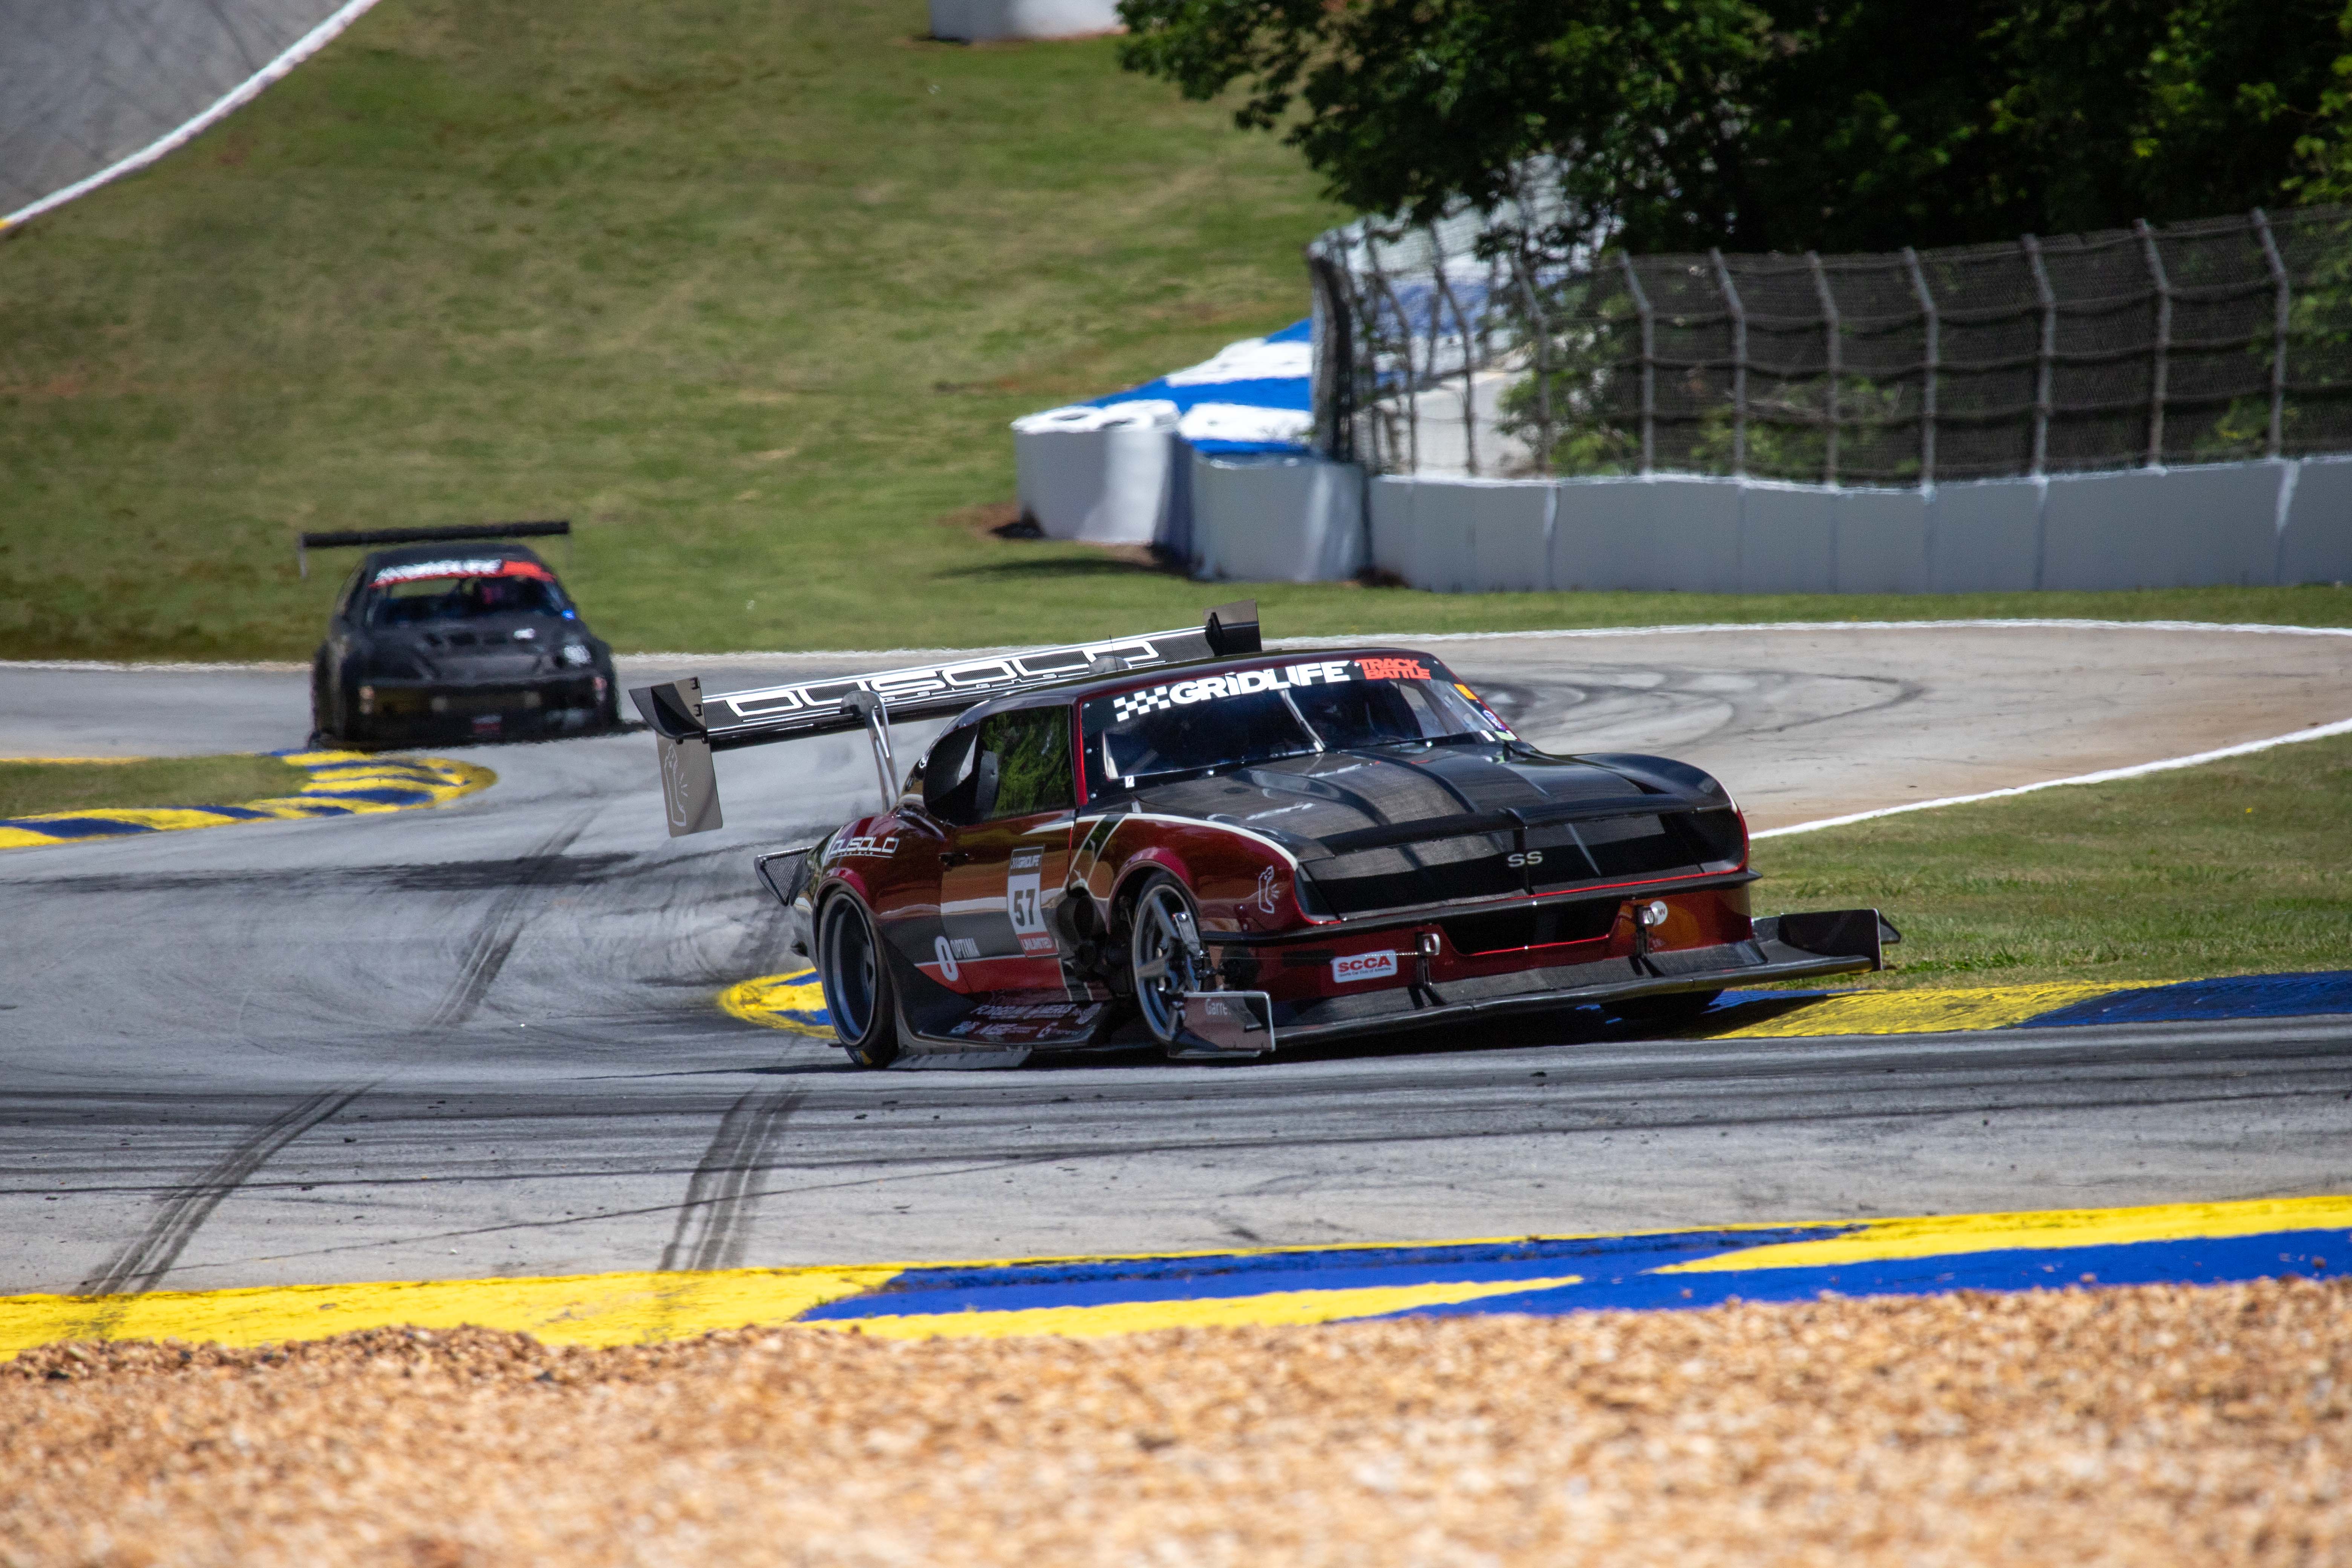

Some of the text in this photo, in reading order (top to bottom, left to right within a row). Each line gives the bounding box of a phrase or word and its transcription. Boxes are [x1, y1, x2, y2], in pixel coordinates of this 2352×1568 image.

[1355, 658, 1421, 670] TRACK
[1169, 660, 1351, 704] GRIDLIFE
[1364, 668, 1431, 680] BATTLE
[1508, 851, 1543, 867] SS
[1014, 889, 1035, 926] 57
[950, 937, 980, 959] OPTIMA
[1338, 956, 1392, 972] SCCA
